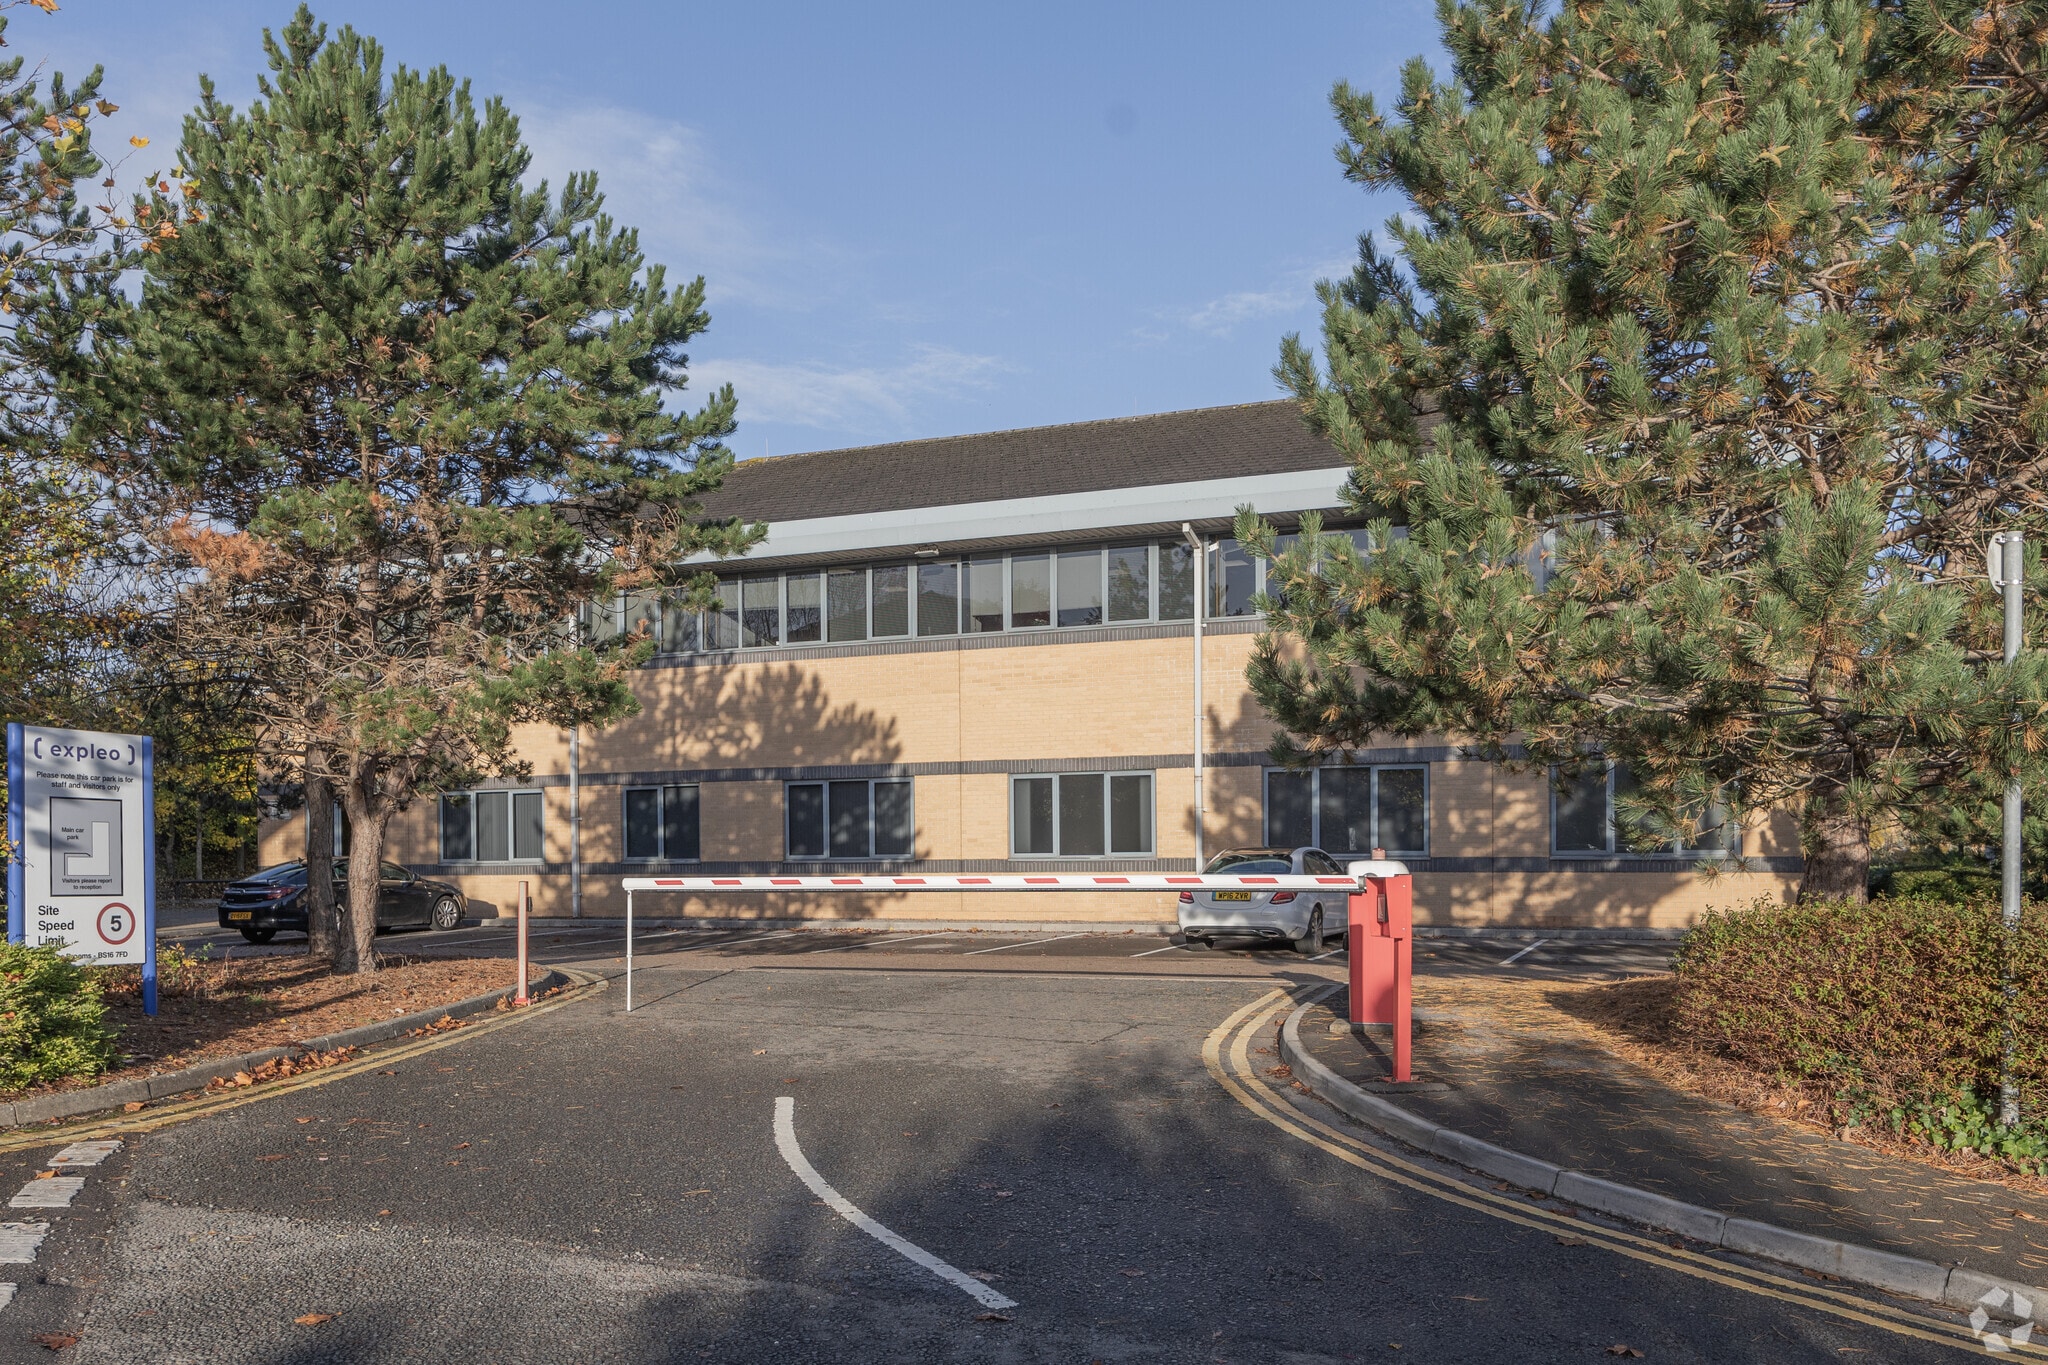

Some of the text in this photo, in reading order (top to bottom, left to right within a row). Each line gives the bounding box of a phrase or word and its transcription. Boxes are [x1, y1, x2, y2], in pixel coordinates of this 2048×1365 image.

[50, 743, 120, 762] expleo
[36, 771, 59, 779] Please
[76, 773, 89, 781] this
[107, 784, 121, 792] only
[1234, 892, 1249, 900] ZVR
[38, 905, 59, 915] Site
[38, 920, 74, 933] Speed
[110, 915, 122, 932] 5
[38, 935, 65, 947] Limit
[97, 951, 114, 959] BS16
